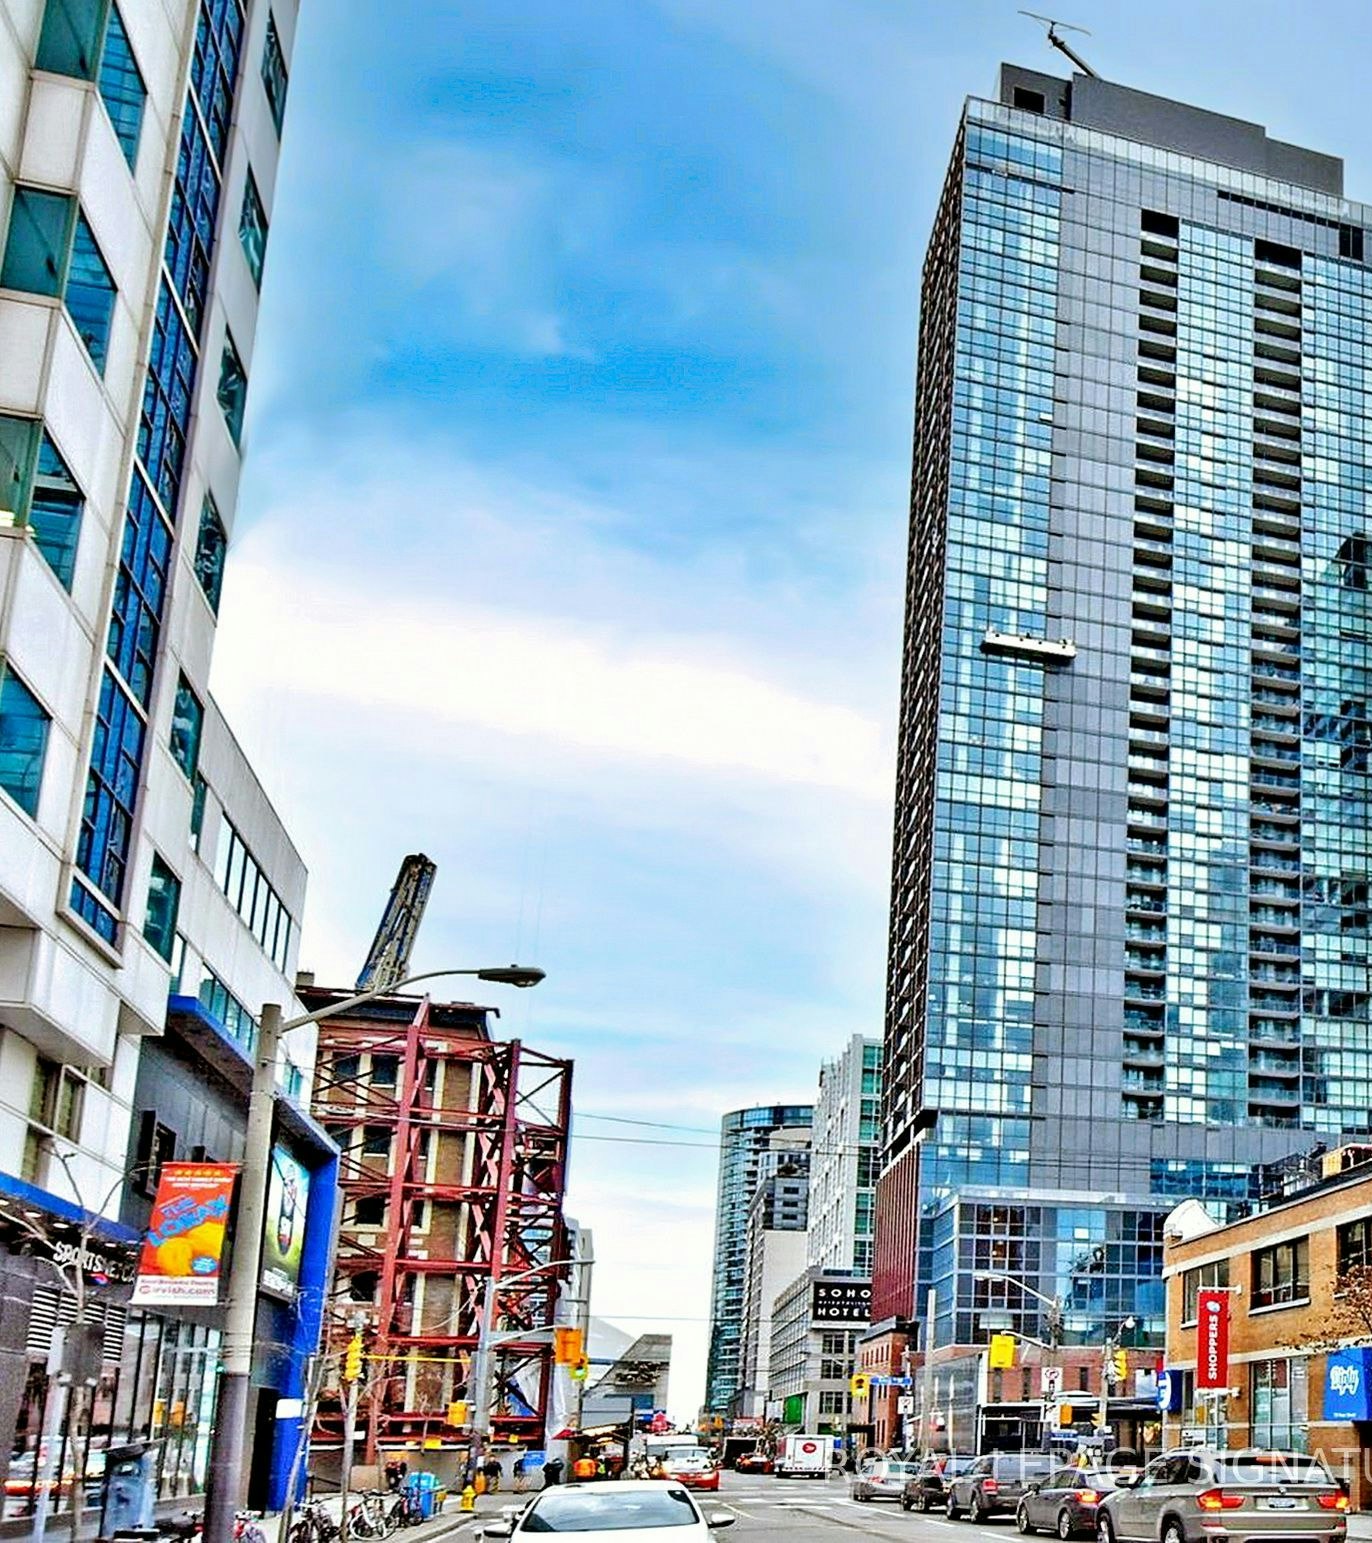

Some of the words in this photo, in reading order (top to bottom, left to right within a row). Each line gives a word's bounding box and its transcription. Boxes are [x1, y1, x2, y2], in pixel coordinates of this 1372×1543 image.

[818, 1288, 872, 1299] SOHO
[817, 1307, 871, 1317] HOTEL
[1208, 1314, 1219, 1380] SHOPPERS
